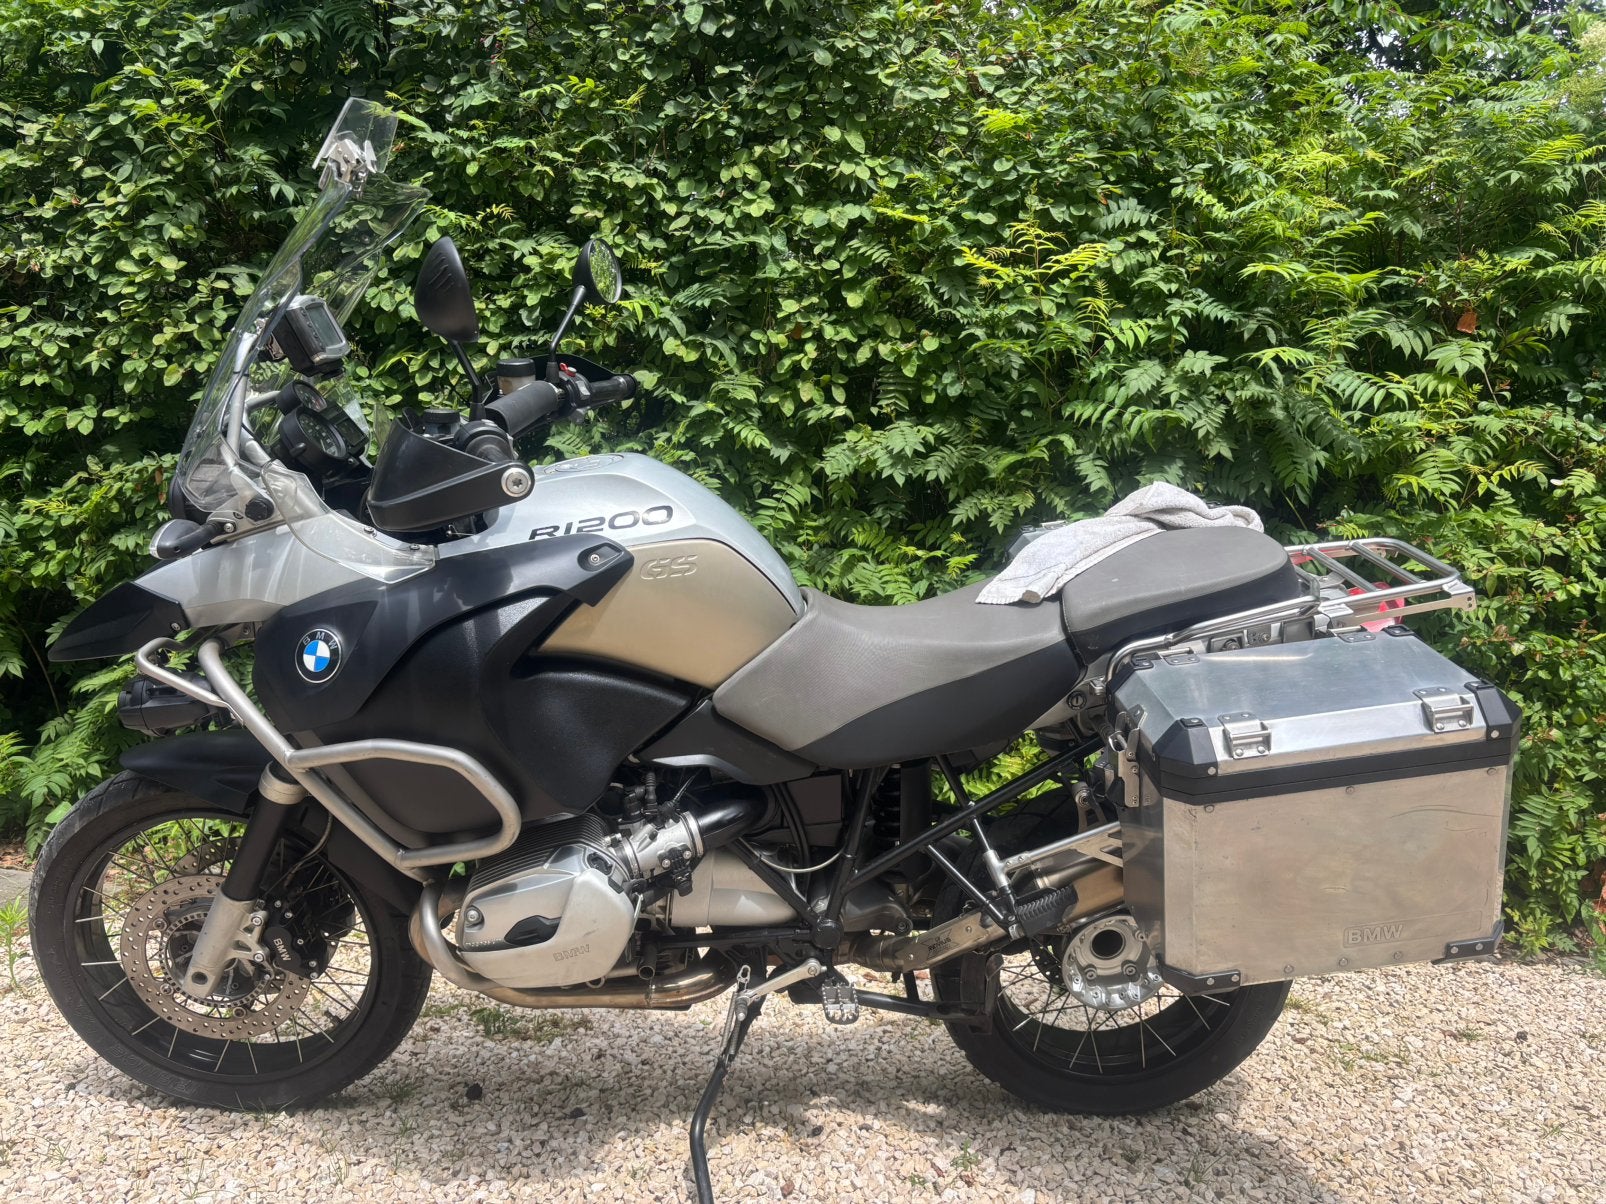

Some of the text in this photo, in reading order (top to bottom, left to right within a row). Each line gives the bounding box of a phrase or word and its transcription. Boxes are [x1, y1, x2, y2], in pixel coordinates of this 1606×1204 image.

[528, 505, 673, 540] R1200
[640, 555, 698, 580] GS
[302, 631, 338, 650] BMW
[1349, 924, 1403, 944] BMW
[273, 938, 292, 961] BMW
[552, 944, 590, 961] BMW
